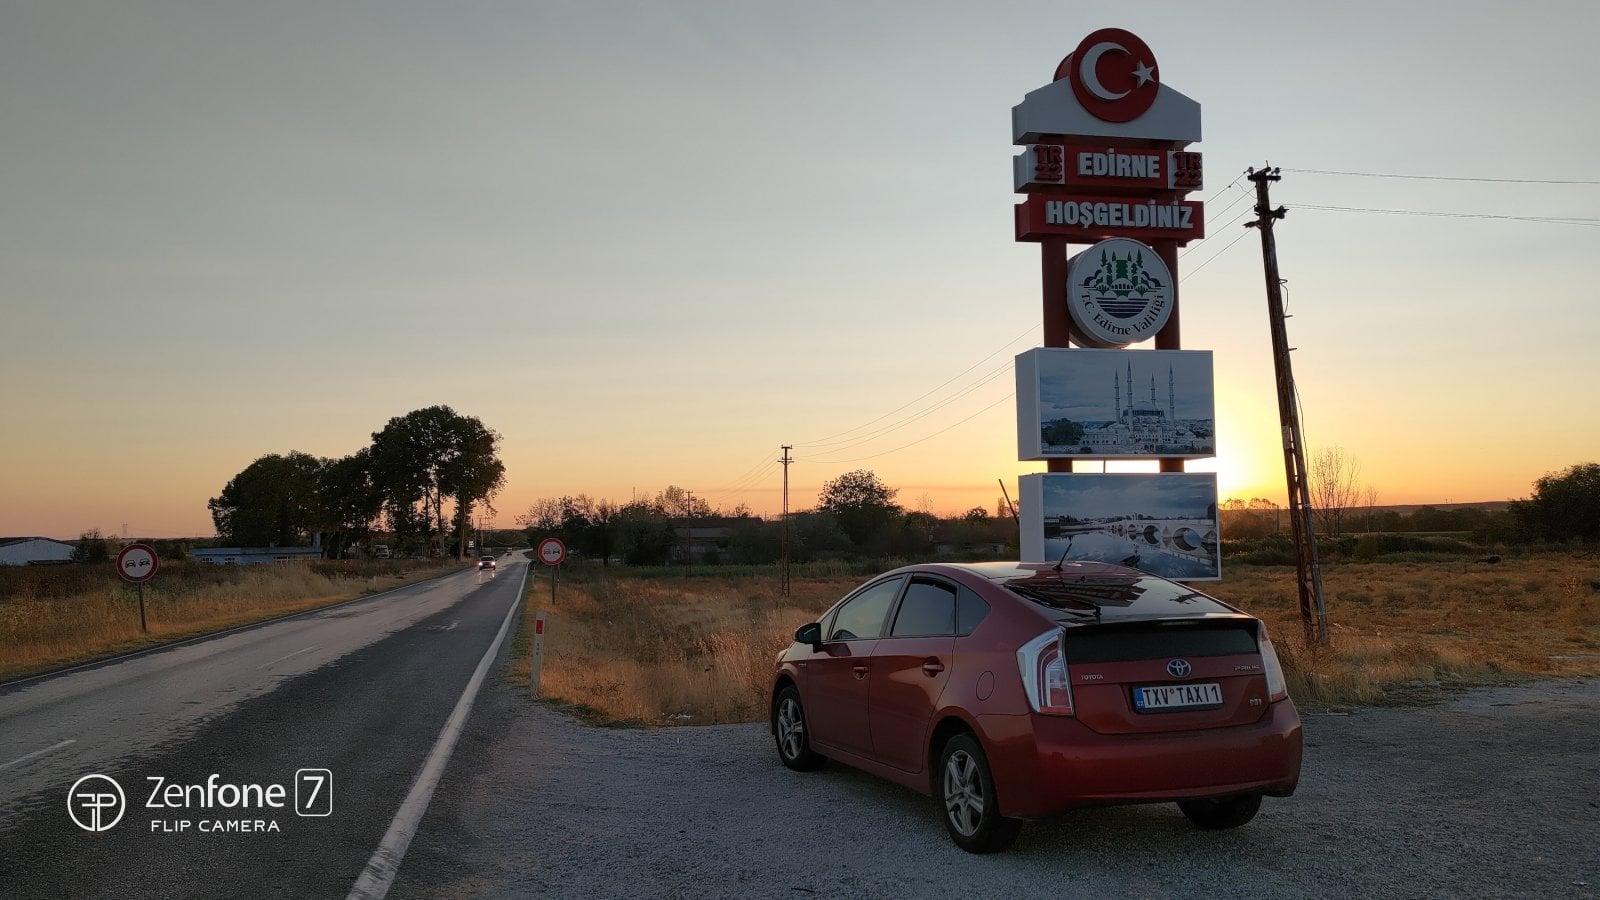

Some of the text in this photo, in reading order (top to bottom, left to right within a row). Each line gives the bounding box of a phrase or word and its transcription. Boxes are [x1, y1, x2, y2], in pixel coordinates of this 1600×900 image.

[1033, 145, 1063, 164] TR
[1078, 148, 1161, 178] EDİRNE
[1173, 152, 1202, 169] TR
[1034, 163, 1063, 181] 22
[1174, 170, 1202, 187] 22
[1046, 200, 1193, 228] HOŞGELDİNİZ
[1093, 314, 1132, 335] Edirne
[1143, 687, 1170, 706] TXV
